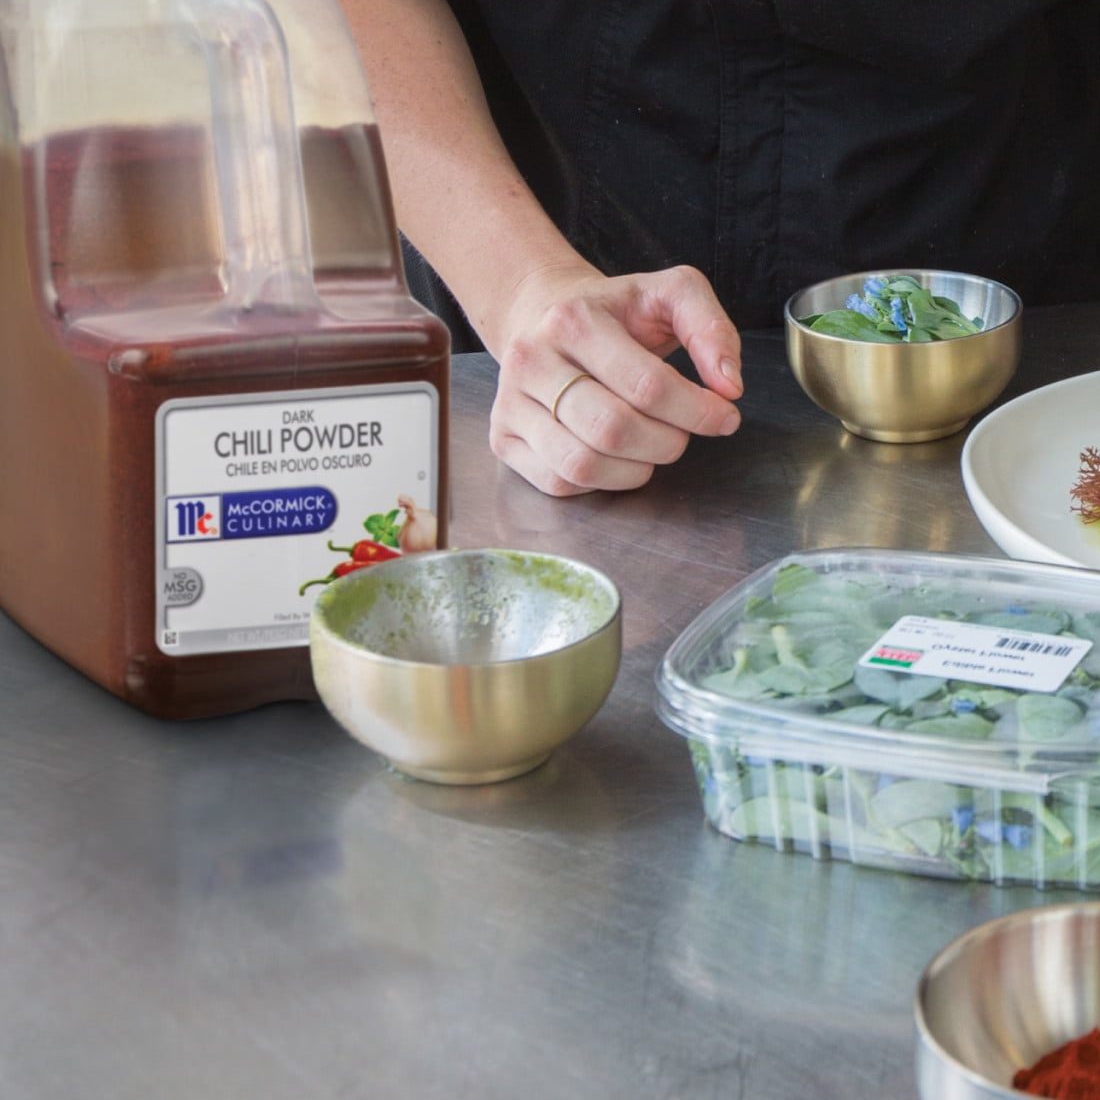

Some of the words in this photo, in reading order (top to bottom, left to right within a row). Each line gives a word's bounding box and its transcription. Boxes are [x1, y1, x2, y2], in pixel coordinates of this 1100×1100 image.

[282, 409, 315, 424] DARK
[214, 428, 273, 458] CHILI
[280, 421, 383, 453] POWDER
[226, 461, 259, 477] CHILE
[261, 460, 278, 475] EN
[280, 457, 320, 474] POLVO
[321, 453, 372, 470] OSCURO
[226, 495, 327, 517] McCORMICK
[226, 512, 327, 533] CULINARY
[173, 571, 188, 580] NO
[164, 579, 198, 594] MSG
[167, 592, 194, 602] ADDED
